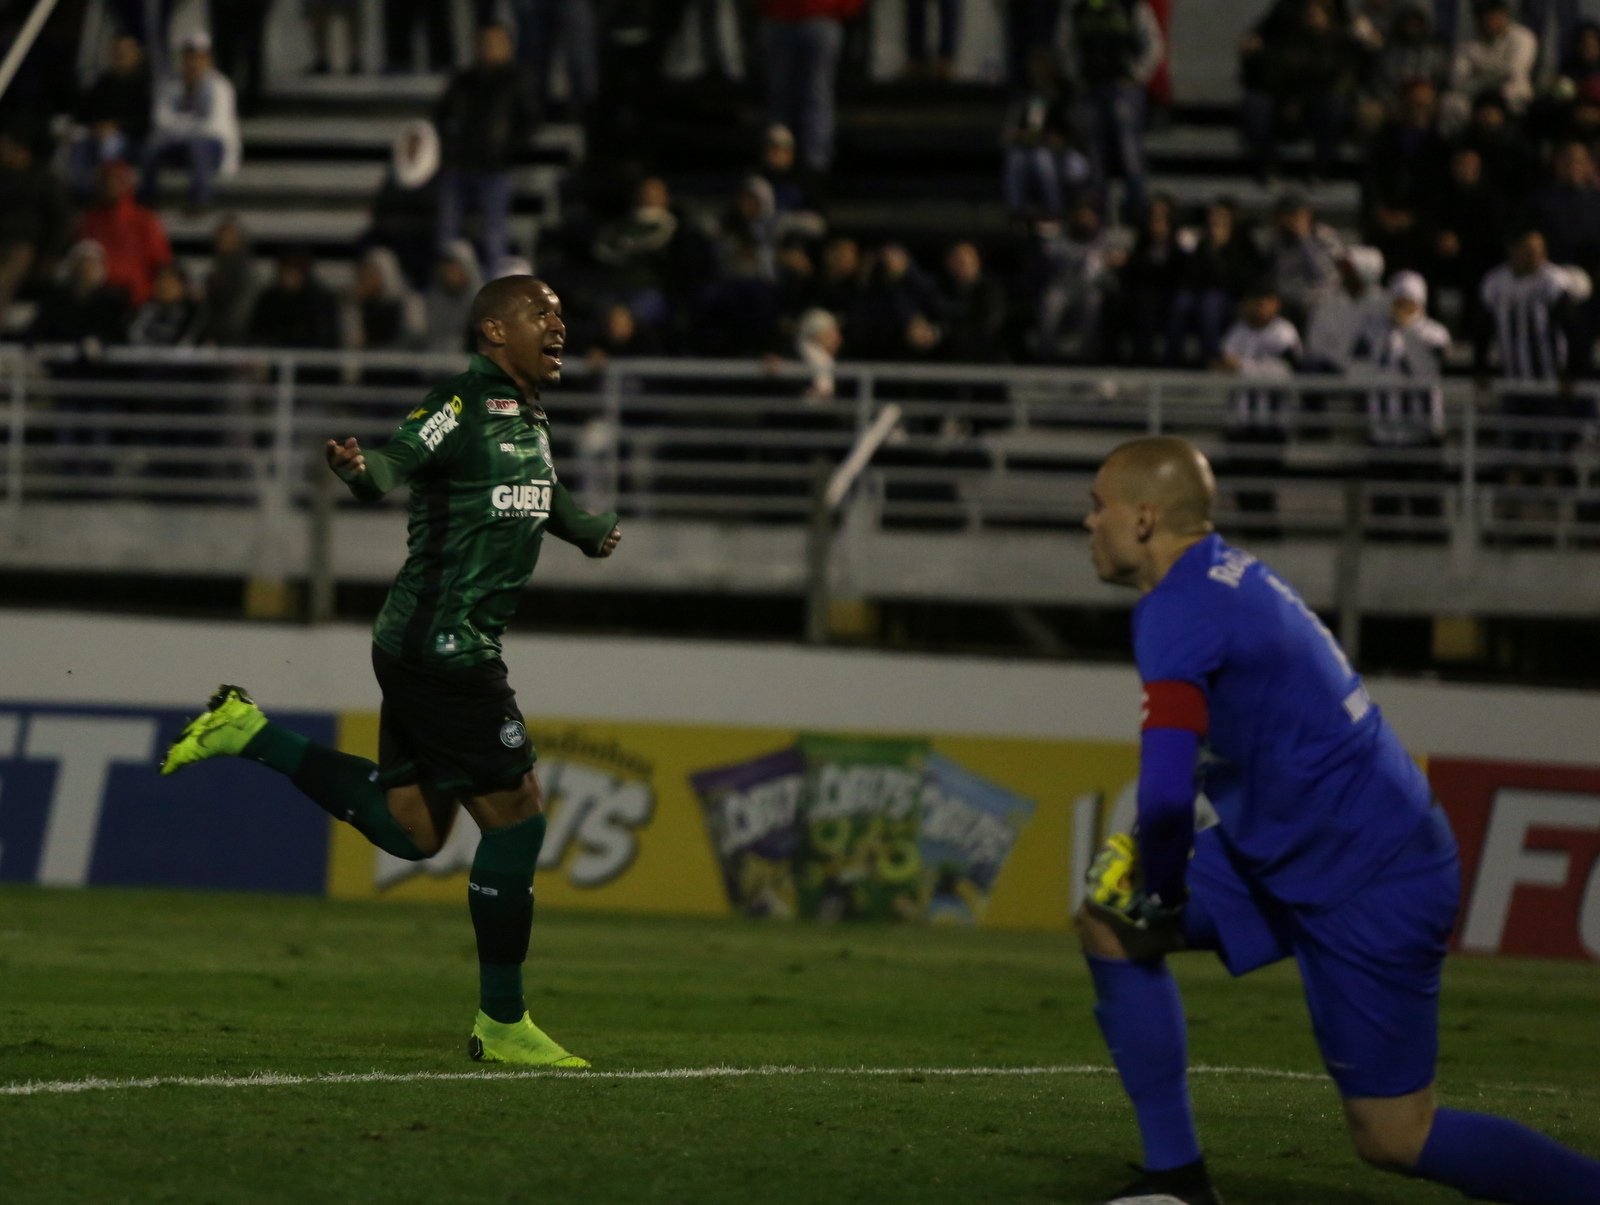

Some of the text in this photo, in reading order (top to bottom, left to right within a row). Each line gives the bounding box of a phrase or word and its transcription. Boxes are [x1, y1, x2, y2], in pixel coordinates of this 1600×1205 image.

[418, 410, 446, 441] PRO
[425, 417, 460, 452] TORK
[491, 484, 554, 511] GUERR
[0, 712, 159, 887] T
[1460, 786, 1600, 960] F
